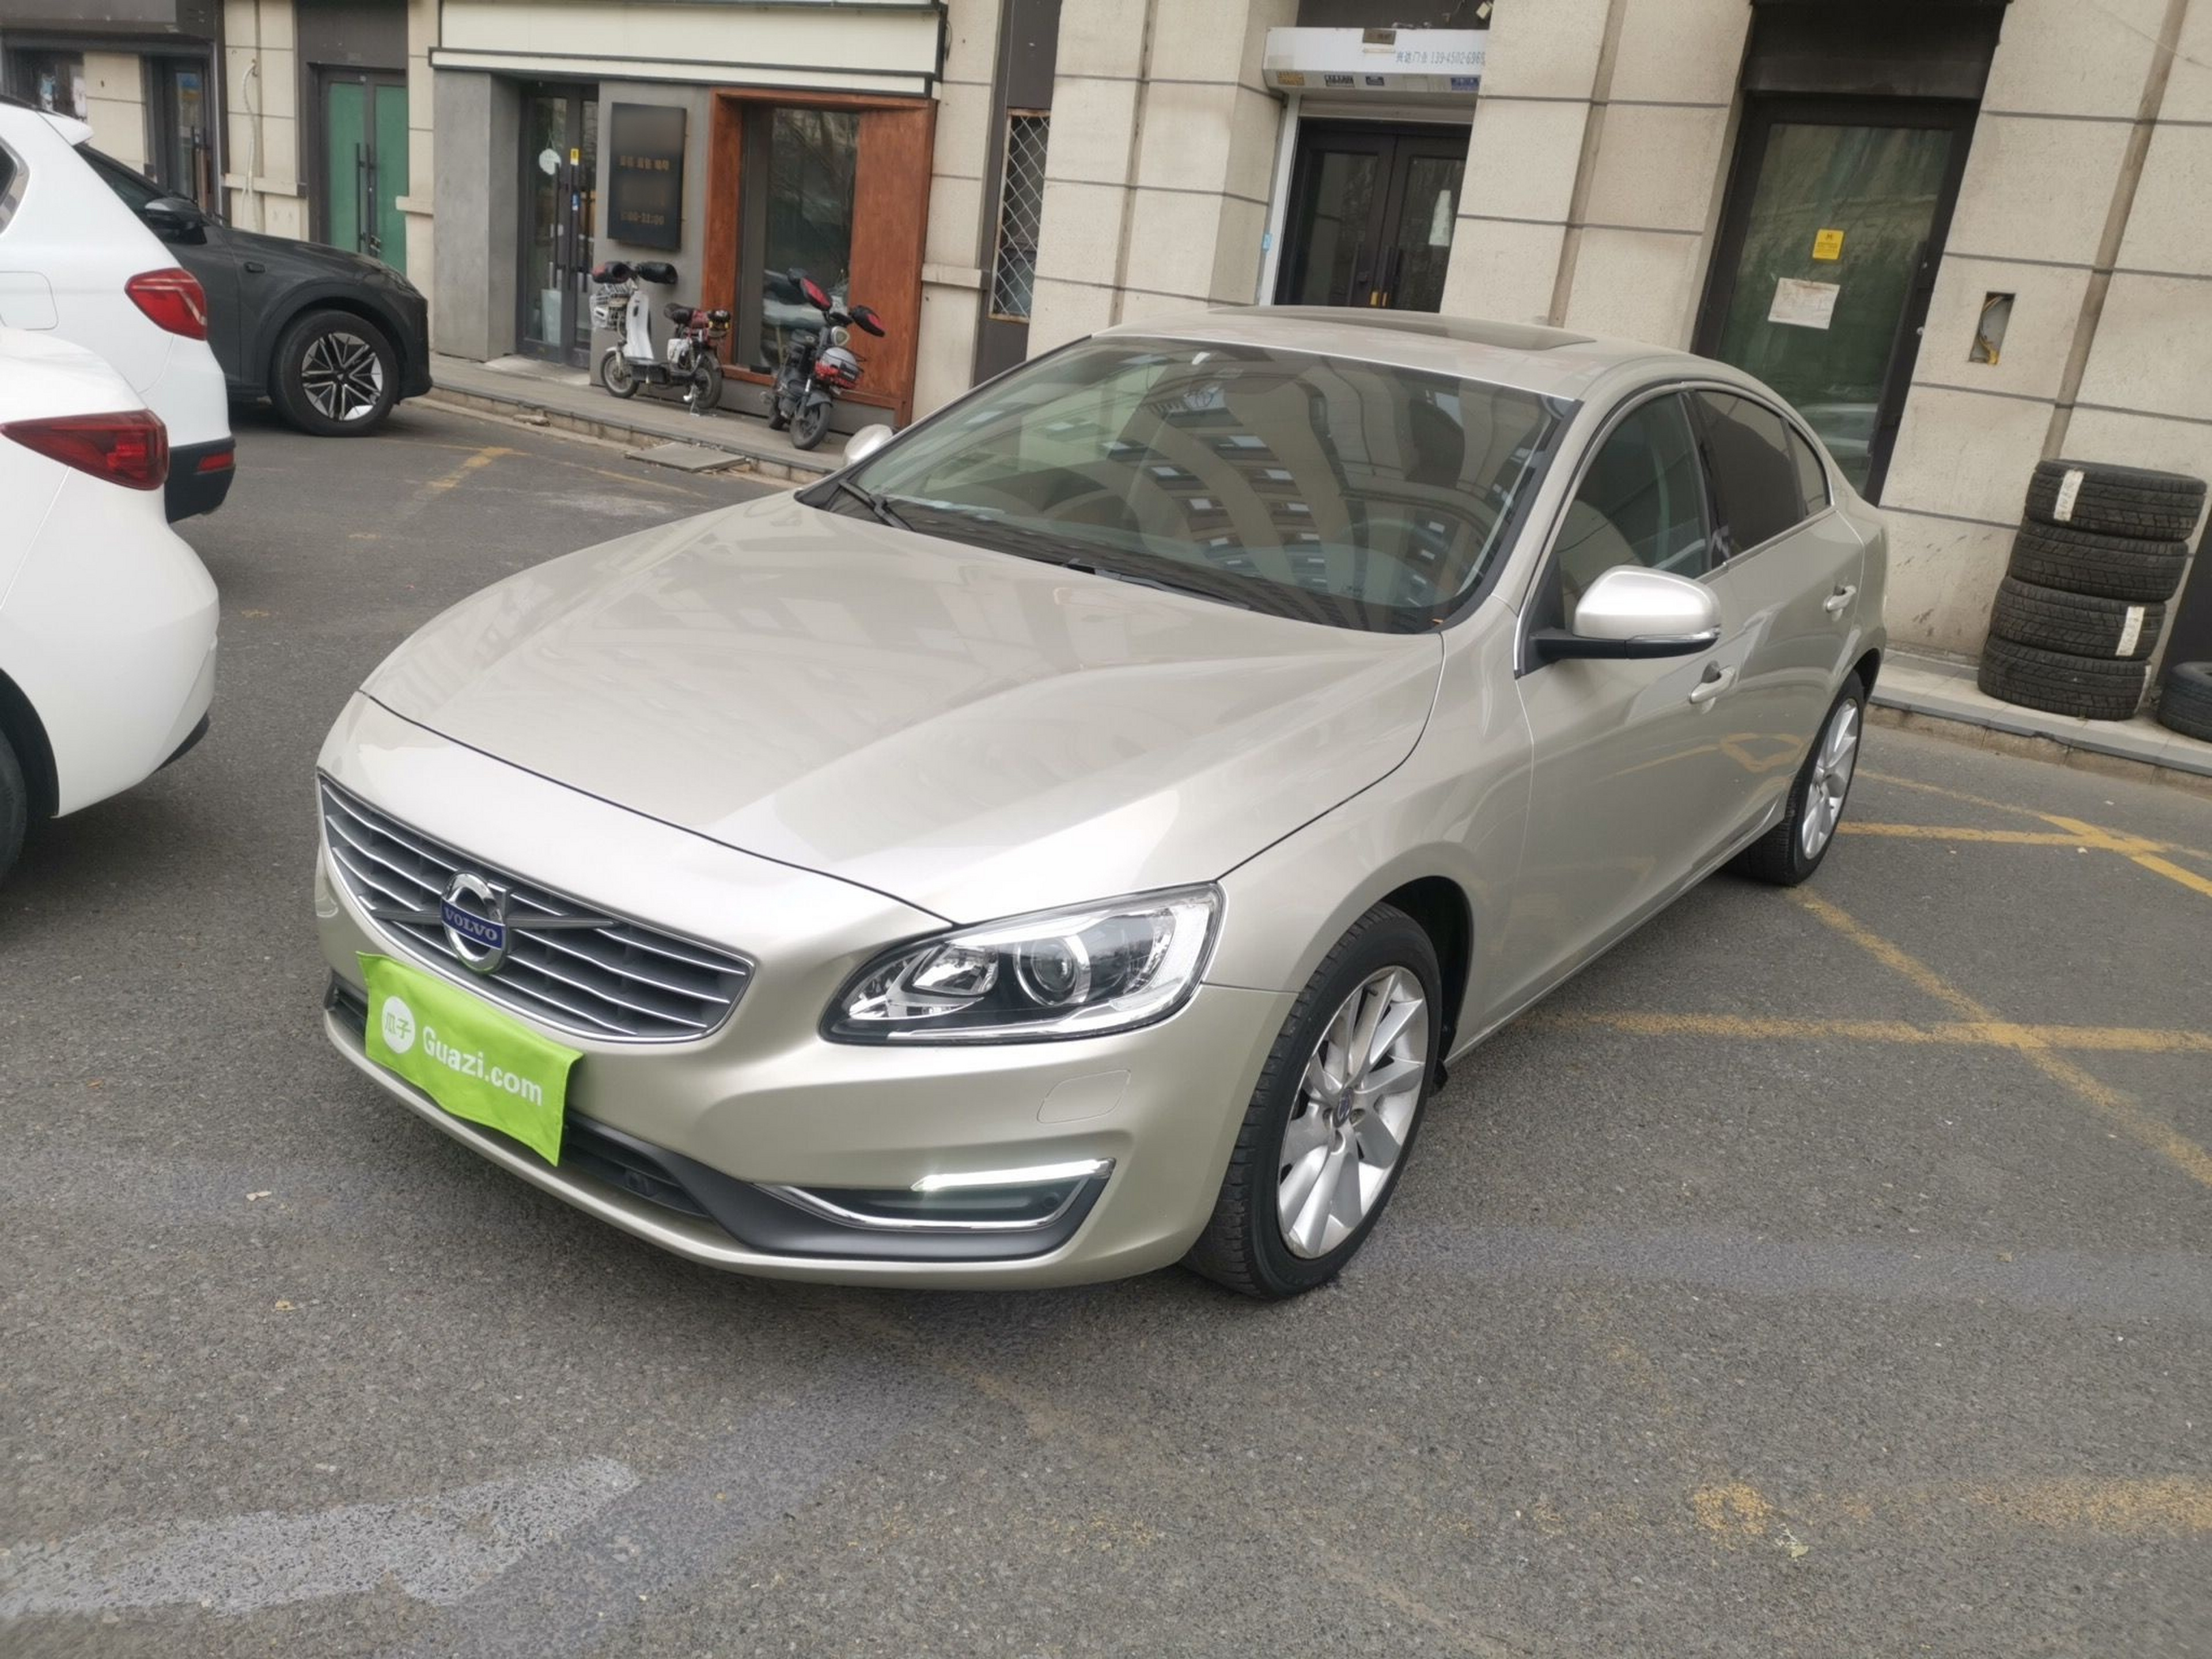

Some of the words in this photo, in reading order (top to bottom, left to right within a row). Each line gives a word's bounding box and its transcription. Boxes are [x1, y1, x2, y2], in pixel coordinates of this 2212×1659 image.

[444, 906, 498, 941] VOLVO
[385, 1012, 412, 1039] 瓜子
[423, 1025, 543, 1107] Guazi.com
